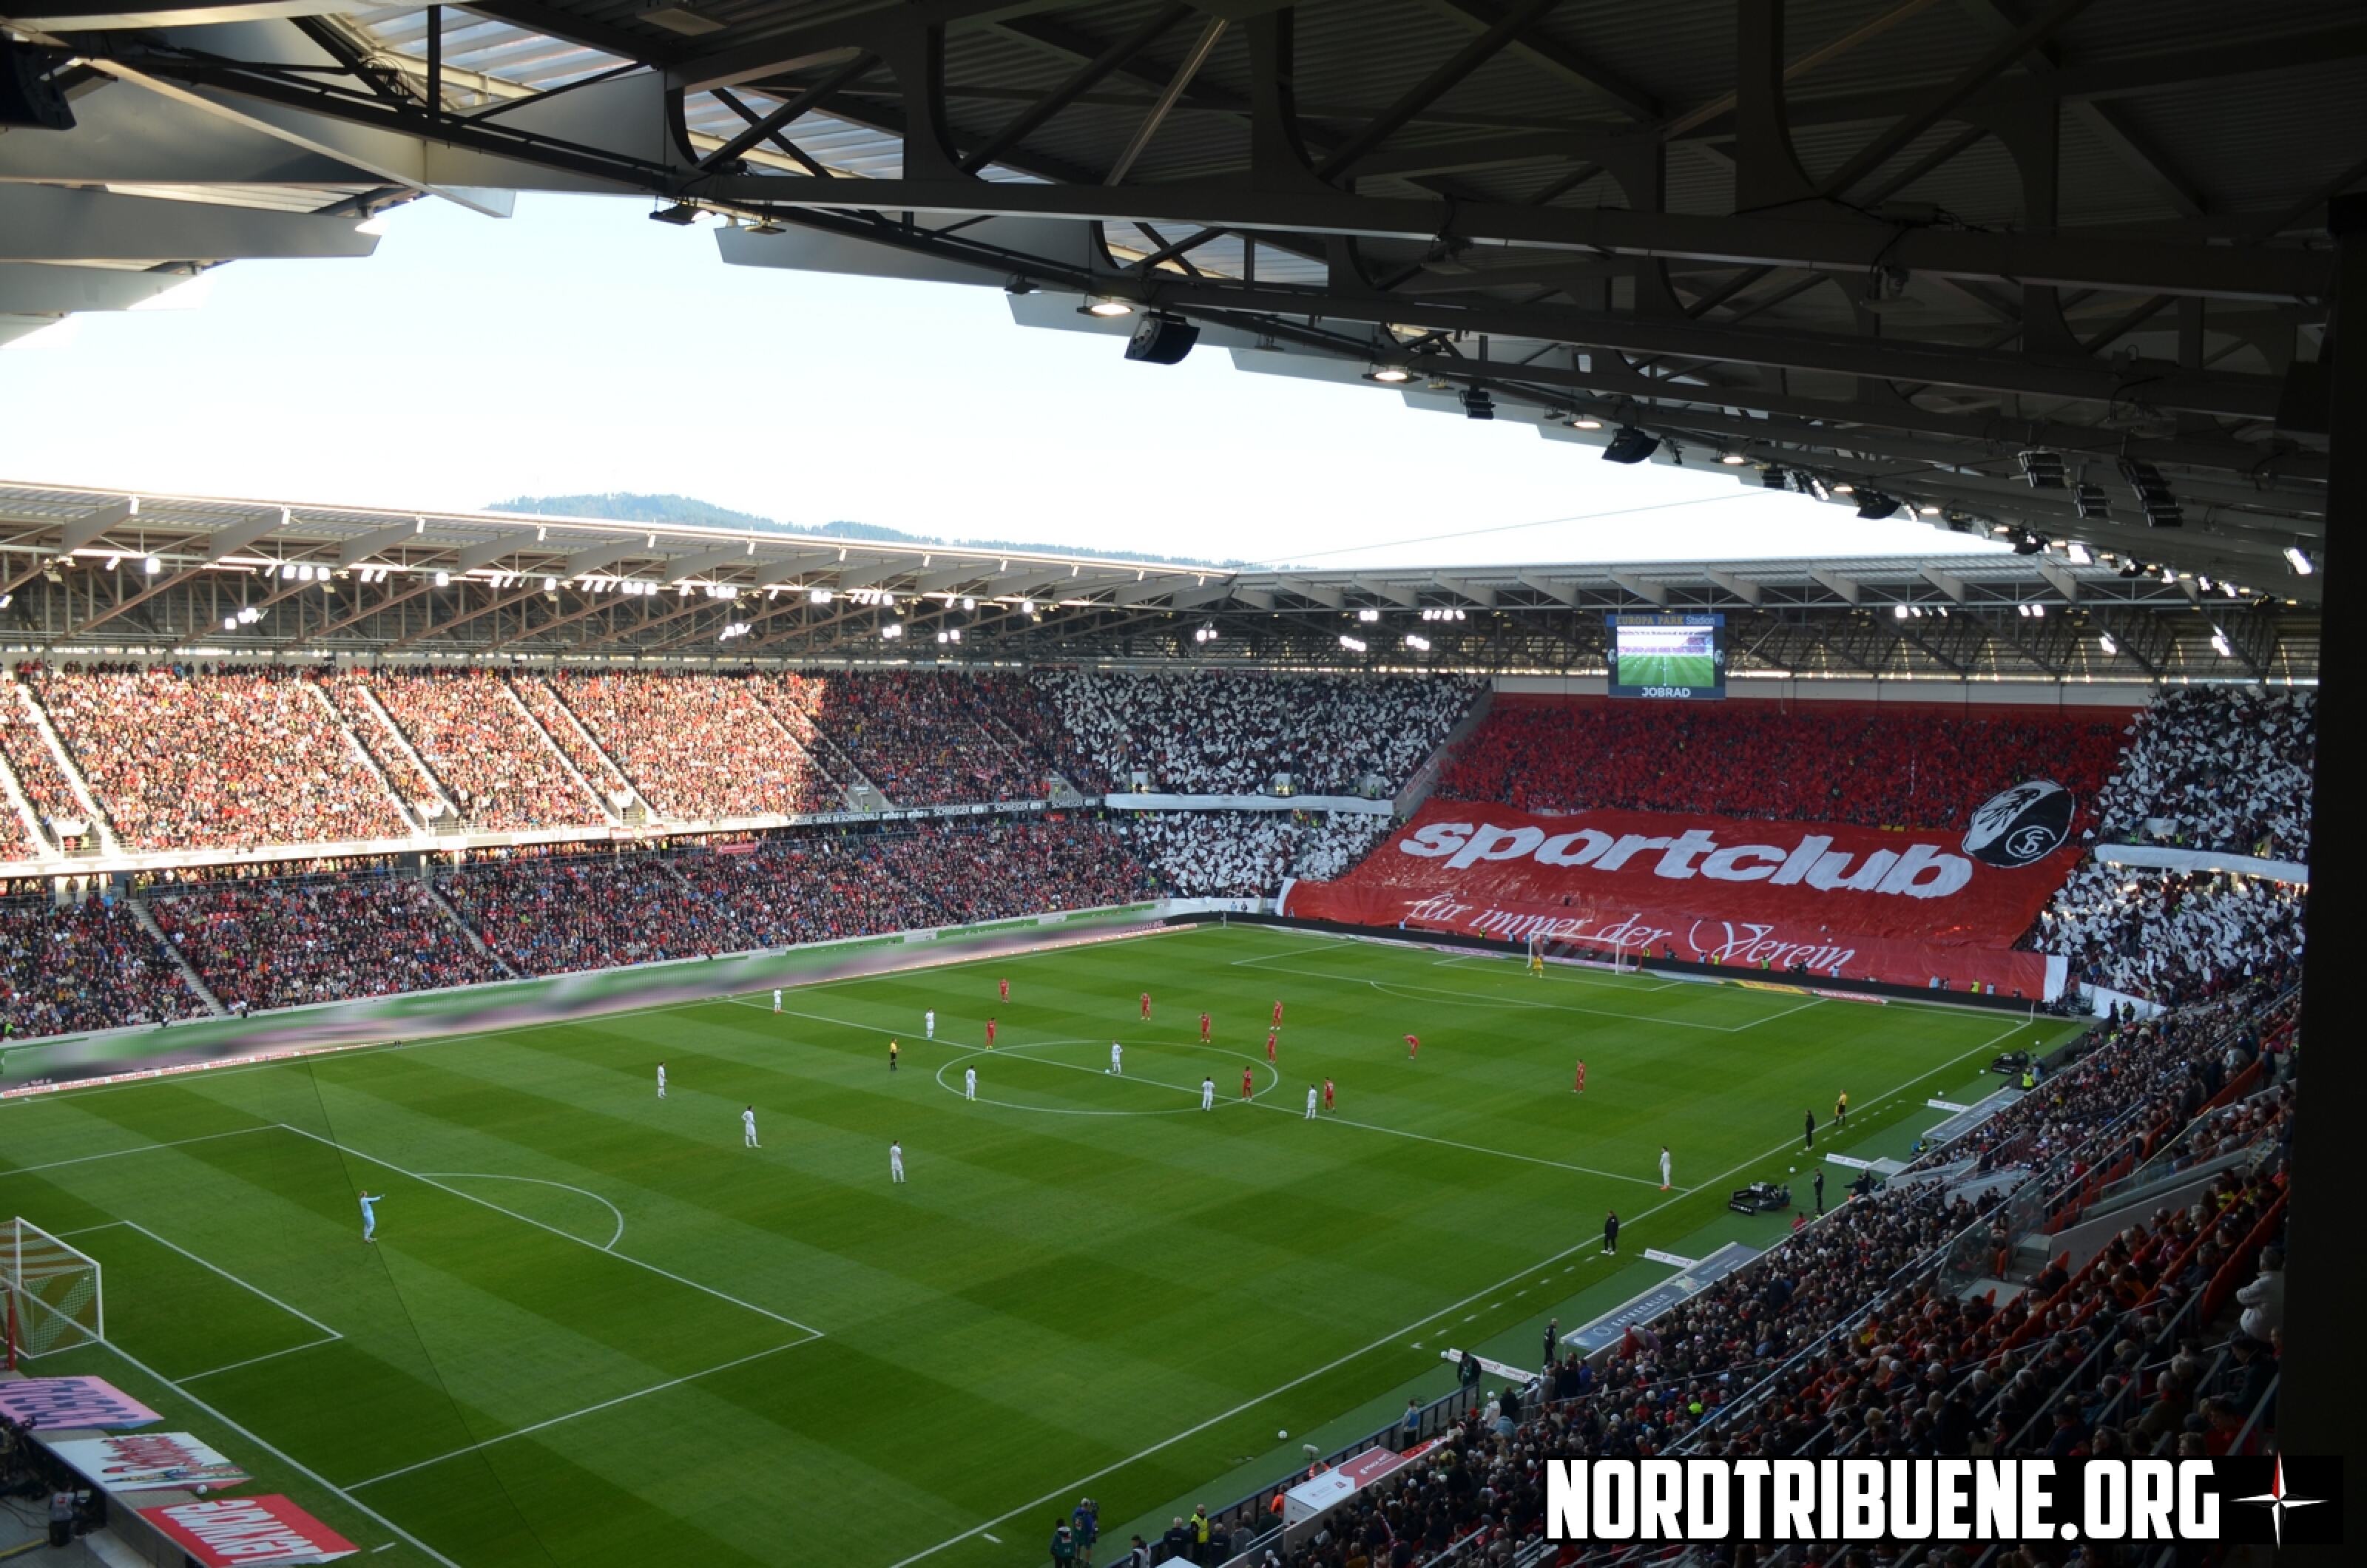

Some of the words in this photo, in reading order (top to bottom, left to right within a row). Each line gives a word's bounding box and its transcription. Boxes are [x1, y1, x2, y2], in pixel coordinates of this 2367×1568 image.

[1615, 616, 1654, 625] EUROPA
[1658, 617, 1685, 625] PARK
[1686, 615, 1715, 625] Stadion
[1641, 687, 1691, 697] JOBRAD
[1399, 822, 1973, 899] sportclub
[1469, 904, 1593, 941] immer
[1596, 913, 1672, 947] der
[1689, 919, 1854, 972] Verein
